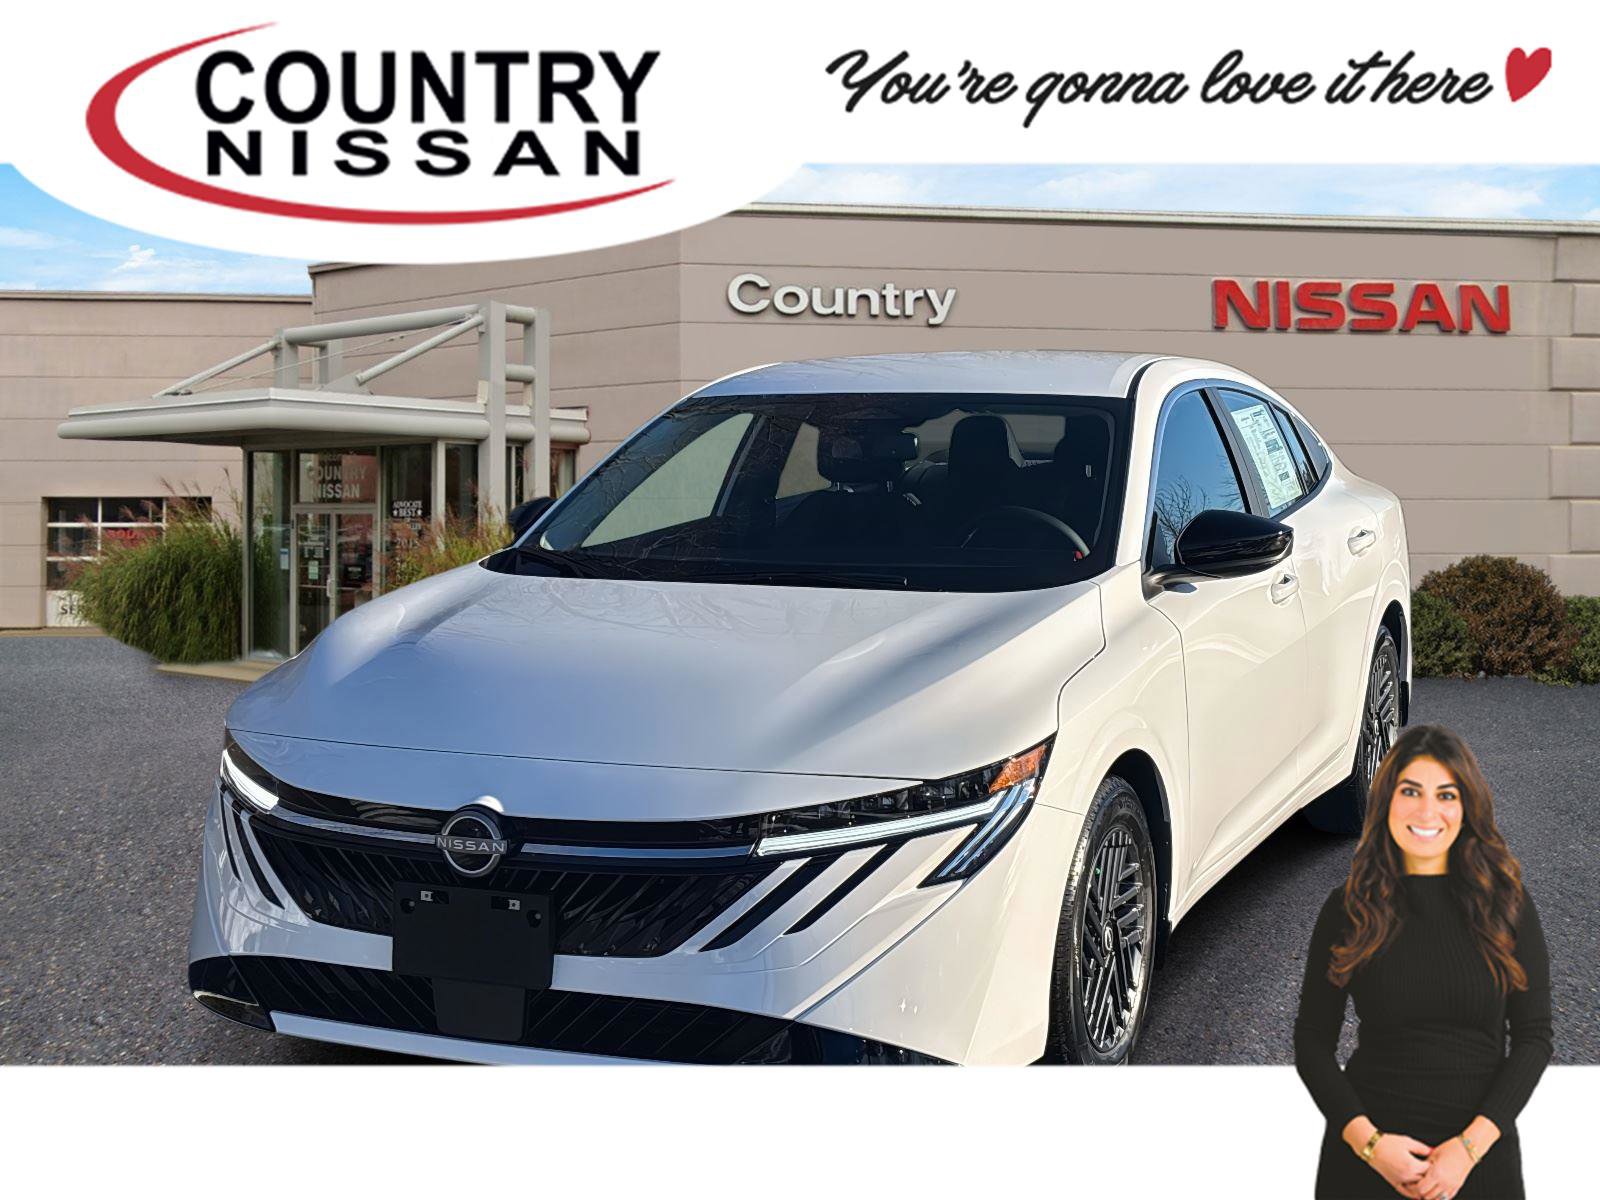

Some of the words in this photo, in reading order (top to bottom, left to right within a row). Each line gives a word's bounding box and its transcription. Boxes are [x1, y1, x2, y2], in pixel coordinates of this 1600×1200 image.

[727, 273, 956, 326] Country
[1212, 278, 1511, 334] NISSAN
[313, 483, 360, 499] NISSAN
[437, 836, 505, 852] NISSAN
